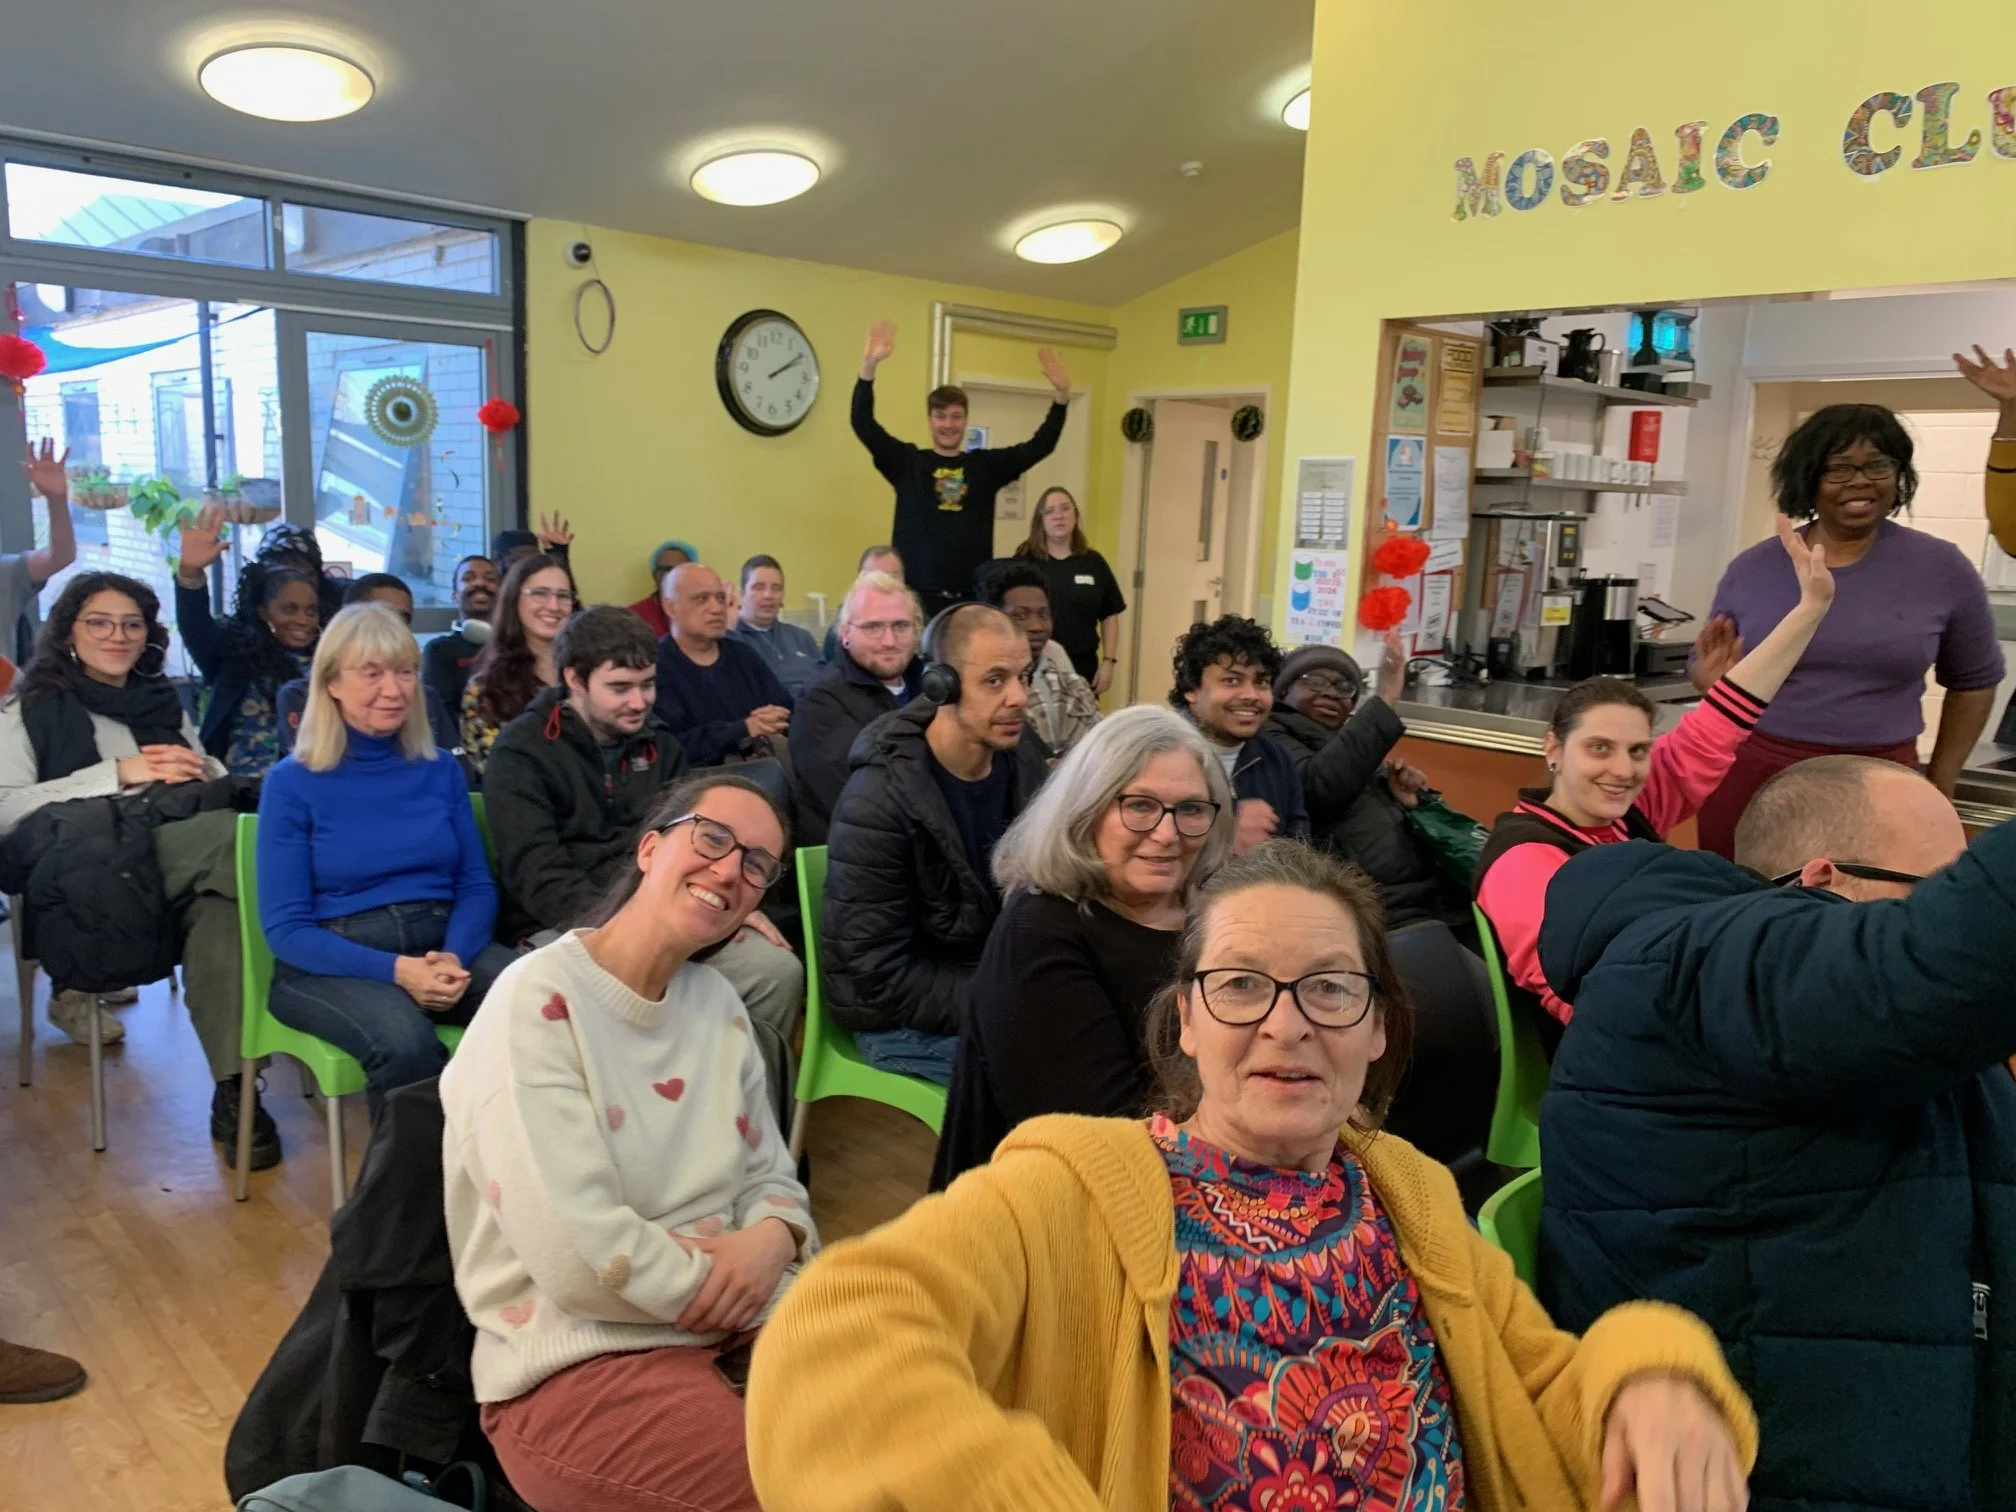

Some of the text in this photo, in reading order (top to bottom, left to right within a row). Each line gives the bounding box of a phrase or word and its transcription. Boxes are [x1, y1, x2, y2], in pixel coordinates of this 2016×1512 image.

[1449, 111, 1780, 222] MOSAIC
[769, 331, 783, 345] 12
[768, 402, 777, 415] 6
